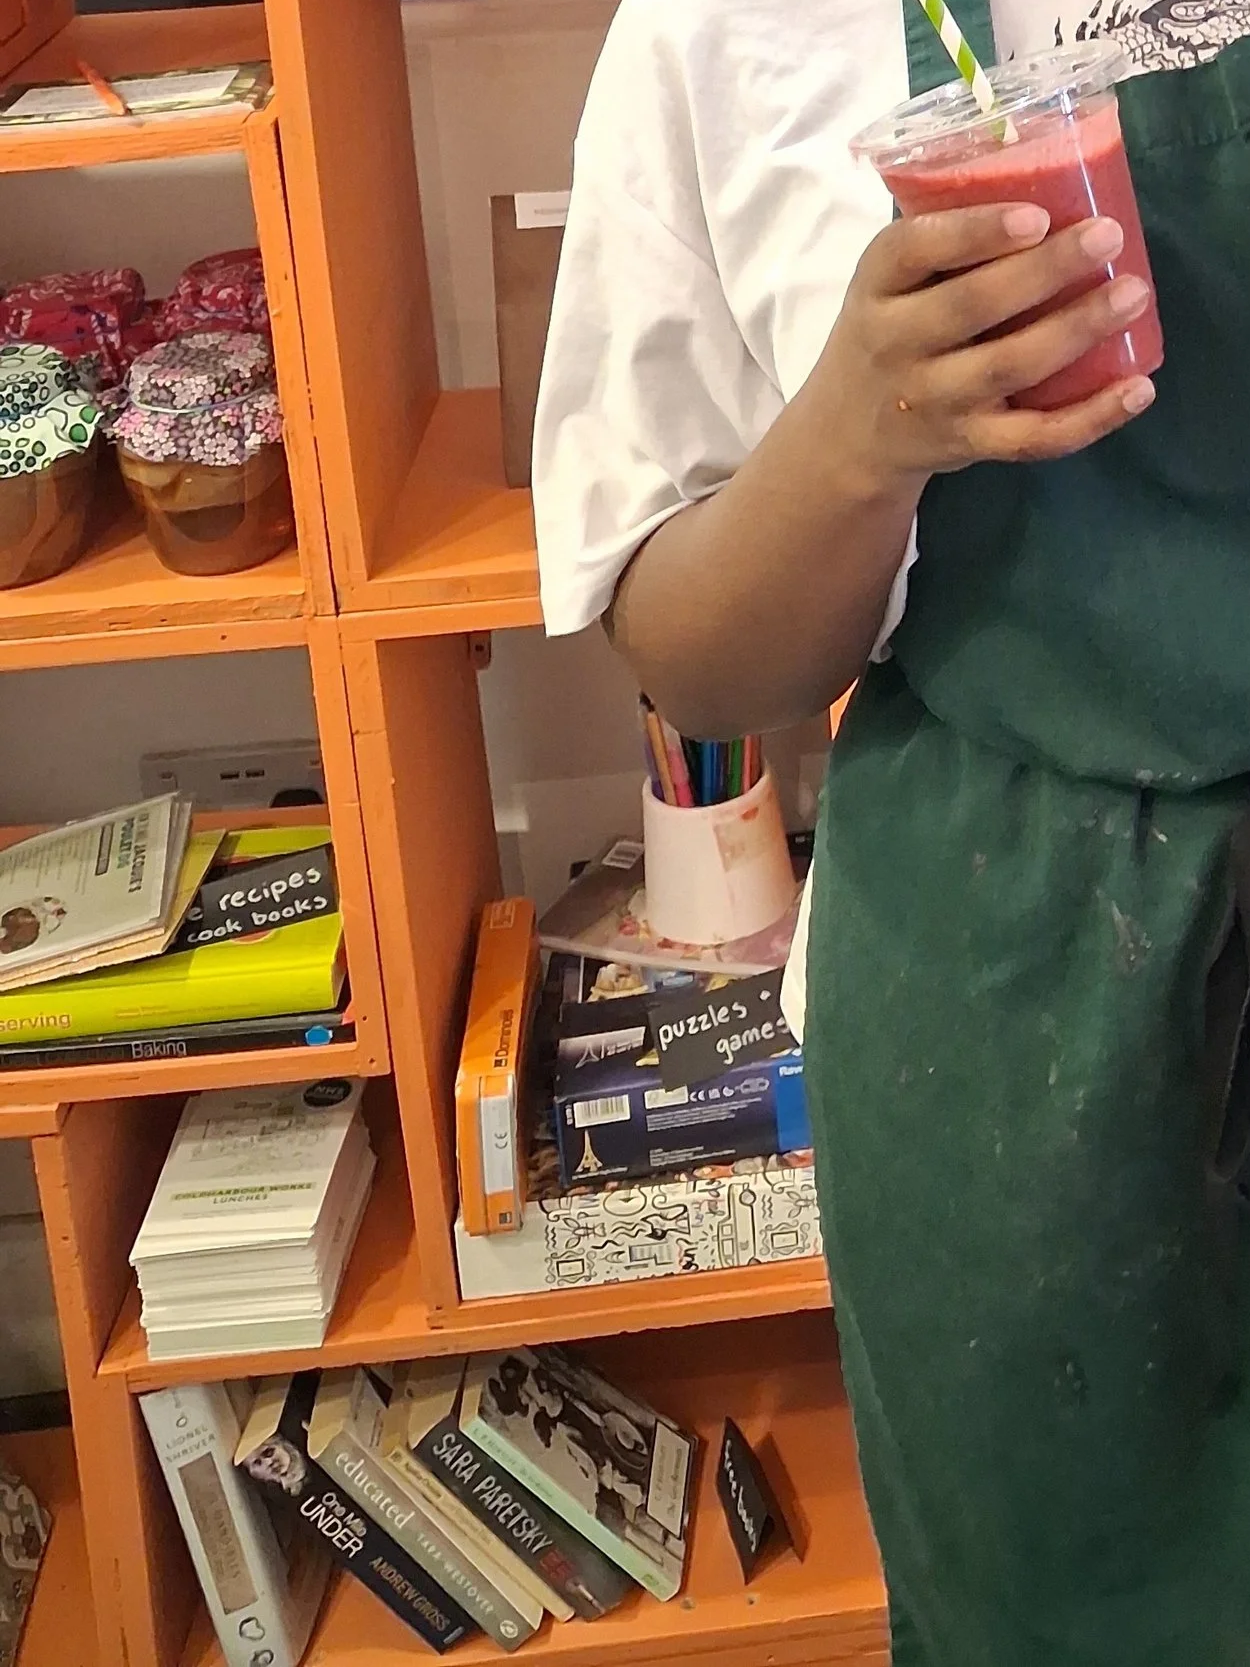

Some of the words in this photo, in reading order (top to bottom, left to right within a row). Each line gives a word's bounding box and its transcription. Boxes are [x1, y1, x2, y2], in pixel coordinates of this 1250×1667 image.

[218, 867, 322, 911] recipes
[187, 918, 243, 943] cook
[251, 895, 329, 926] books
[131, 1040, 188, 1060] Baking
[658, 1001, 748, 1052] puzzles
[715, 1016, 792, 1065] games
[335, 1452, 416, 1530] educated
[432, 1433, 481, 1485] SARA
[472, 1475, 553, 1554] PARETSKY
[300, 1496, 364, 1559] UNDER
